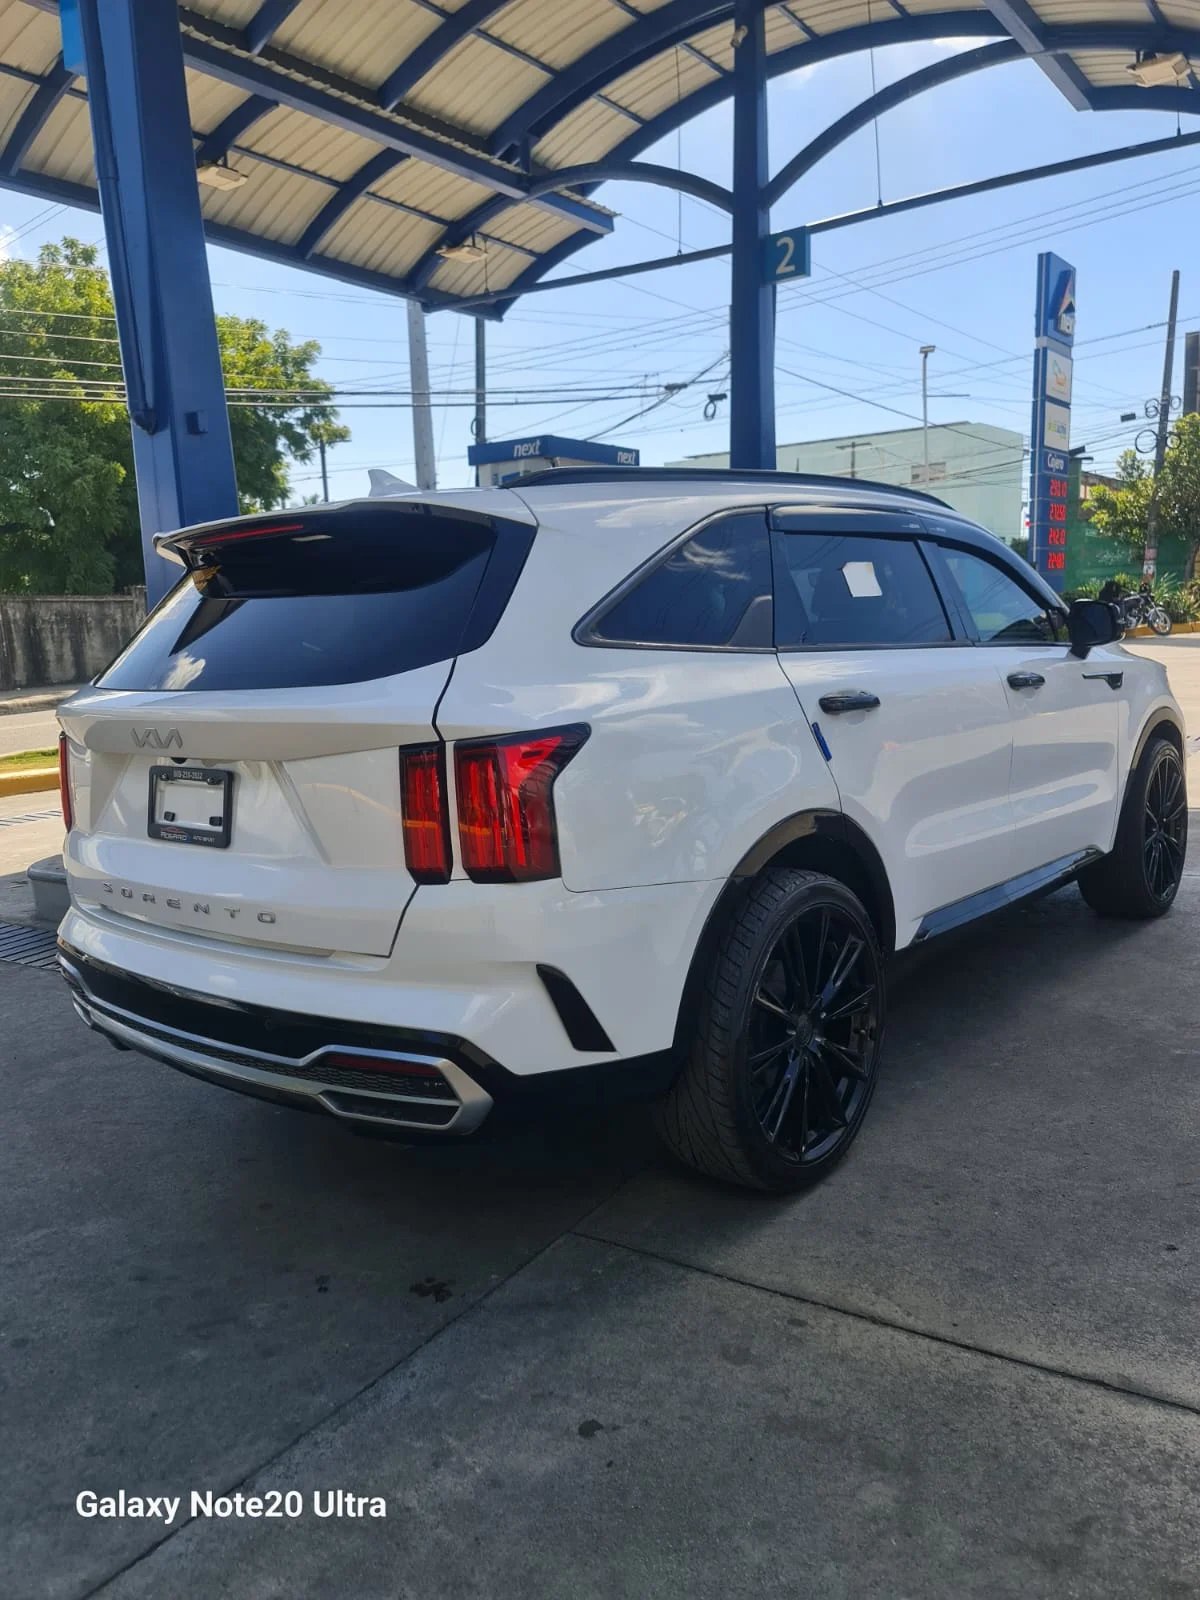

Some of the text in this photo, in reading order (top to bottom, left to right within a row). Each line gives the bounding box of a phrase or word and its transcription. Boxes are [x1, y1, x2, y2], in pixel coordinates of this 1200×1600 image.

[776, 236, 796, 275] 2
[513, 439, 541, 458] next
[617, 450, 637, 465] next
[1047, 453, 1065, 472] Cajero
[131, 728, 183, 749] KIA
[103, 883, 276, 923] SORENTO
